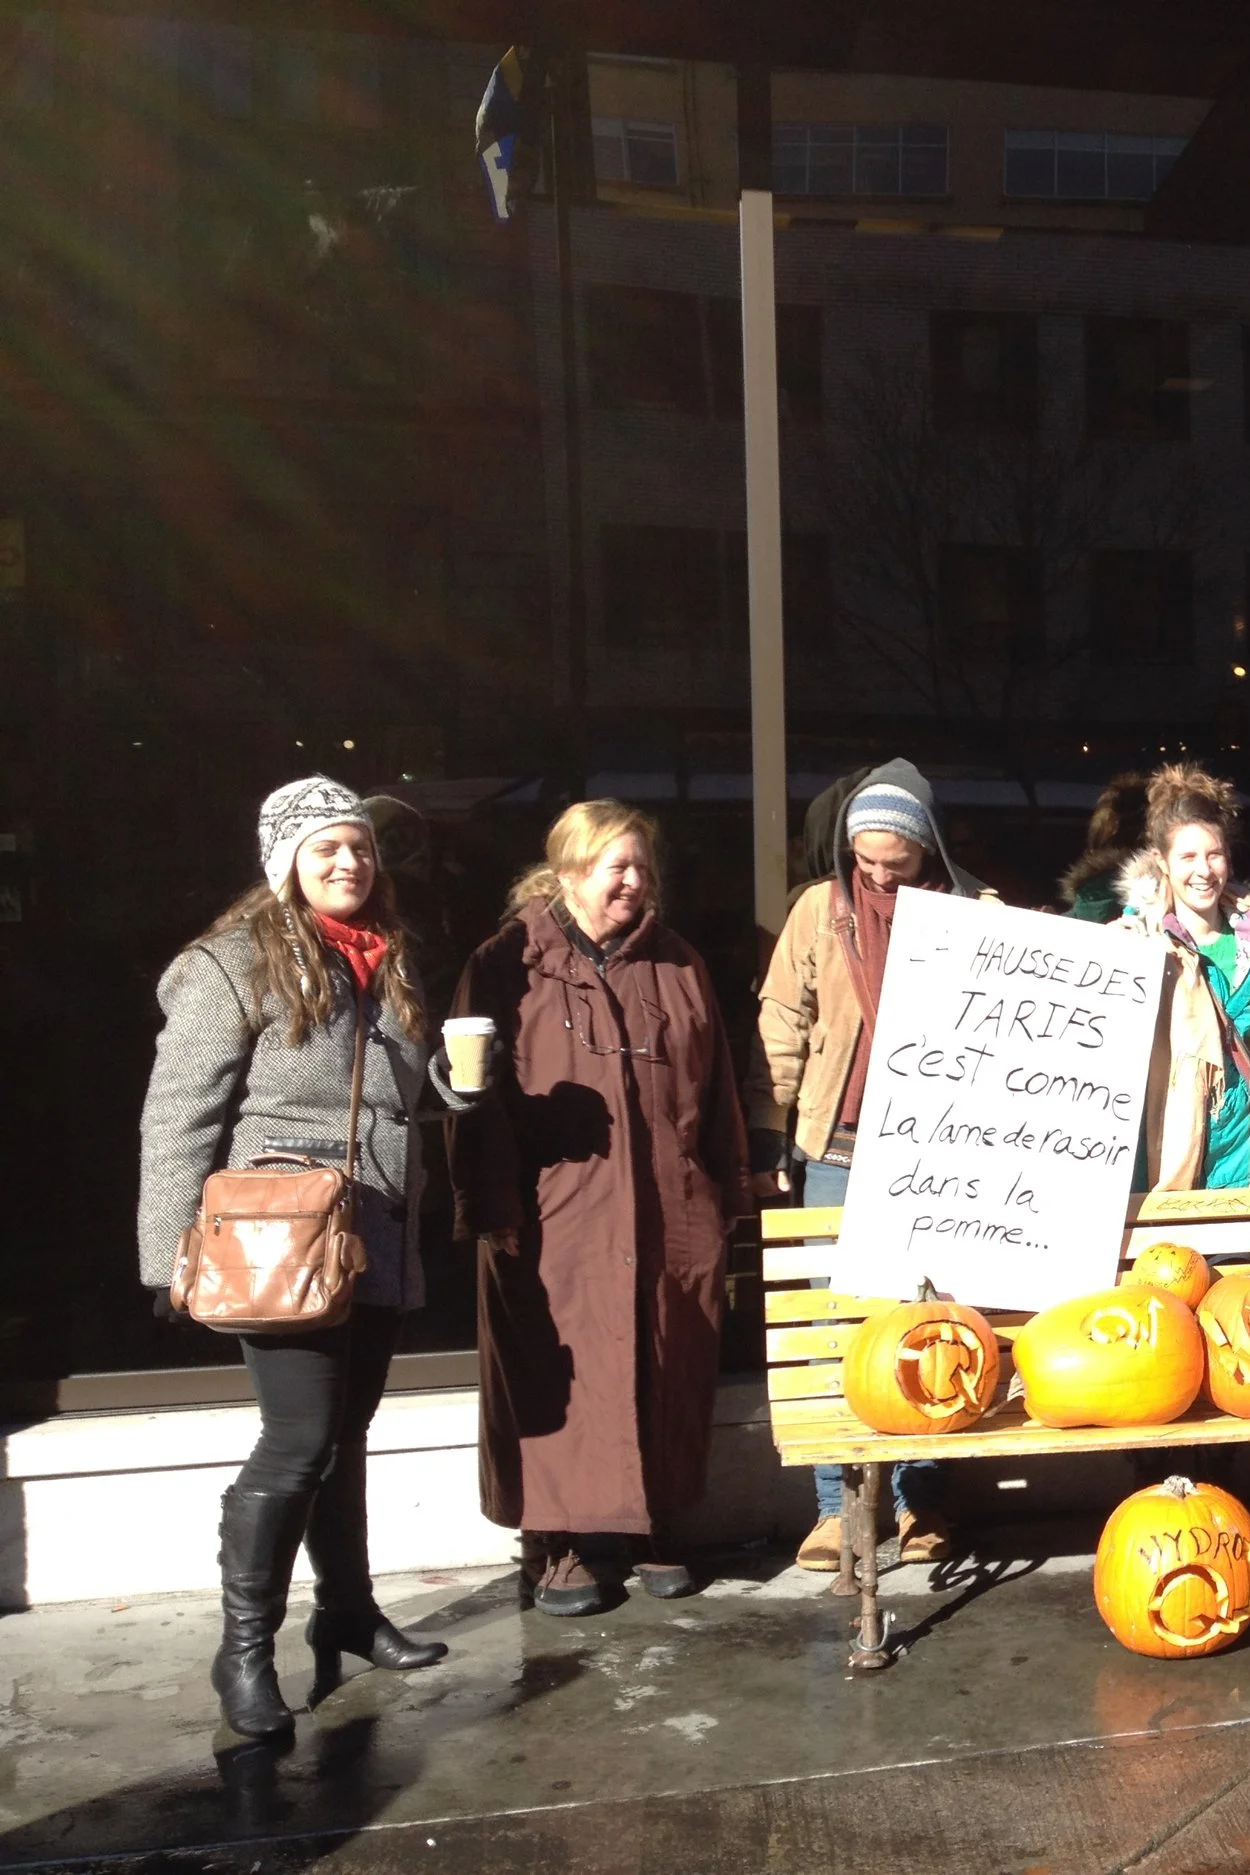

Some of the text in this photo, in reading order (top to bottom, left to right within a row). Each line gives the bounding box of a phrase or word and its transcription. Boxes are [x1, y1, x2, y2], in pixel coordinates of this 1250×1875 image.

[969, 935, 1075, 984] HAUSSE
[1077, 961, 1147, 1004] DES
[954, 990, 1107, 1049] TARIFS
[1005, 1066, 1132, 1121] comme
[888, 1158, 1040, 1214] dans la
